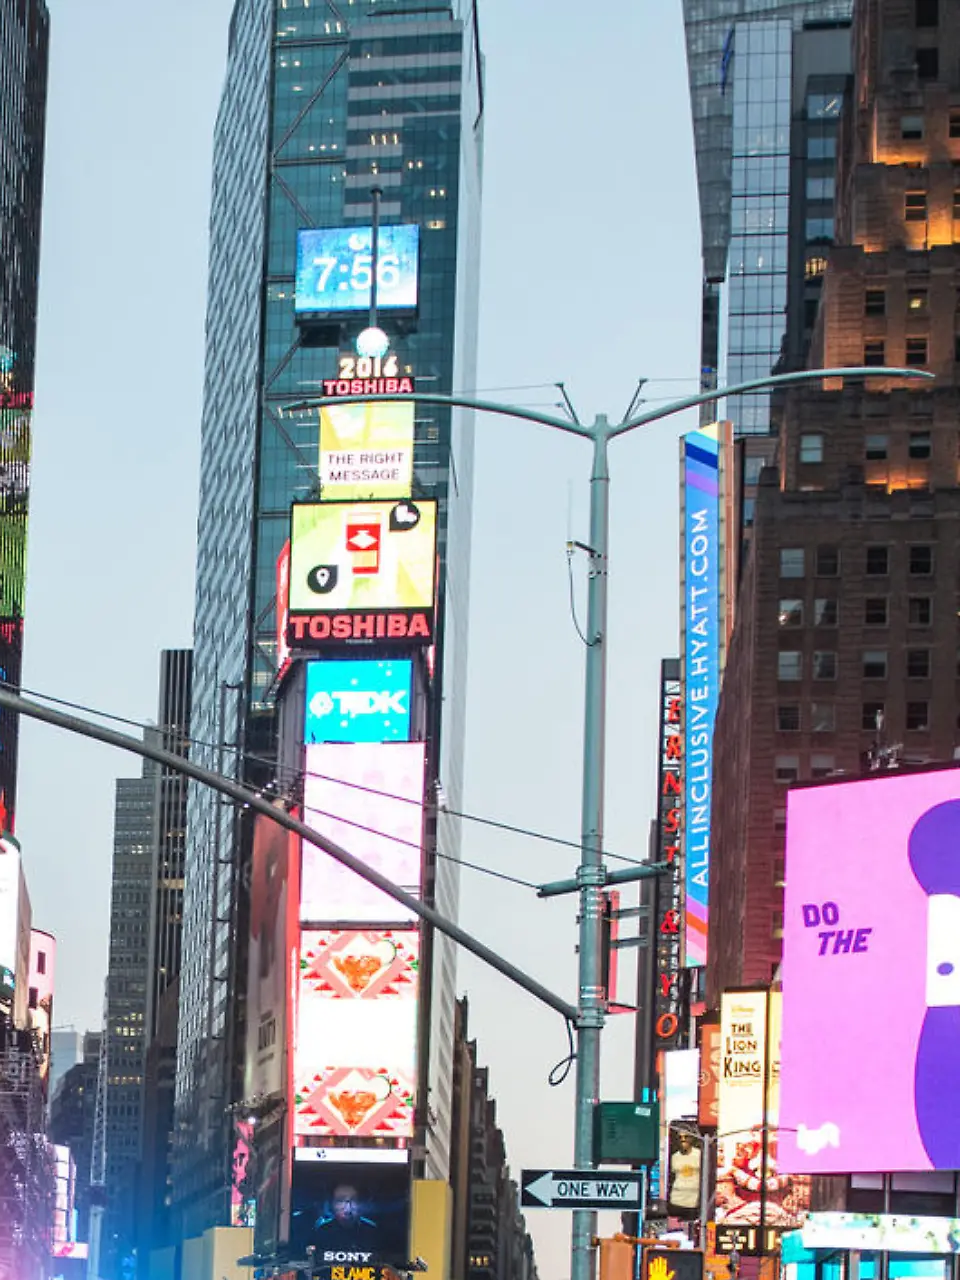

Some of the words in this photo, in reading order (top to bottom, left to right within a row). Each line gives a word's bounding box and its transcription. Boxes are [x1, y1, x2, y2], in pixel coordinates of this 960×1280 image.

[313, 252, 400, 292] 7:56
[338, 355, 399, 379] 2016
[323, 378, 413, 396] TOSHIBA
[328, 453, 354, 466] THE
[359, 452, 404, 465] RIGHT
[328, 469, 400, 481] MESSAGE
[289, 613, 430, 639] TOSHIBA
[331, 690, 407, 716] TDK
[662, 697, 682, 863] ERNST
[802, 901, 840, 928] DO
[818, 928, 873, 956] THE
[731, 1023, 752, 1034] THE
[726, 1036, 758, 1054] LION
[723, 1056, 761, 1079] KING
[557, 1182, 589, 1197] ONE
[596, 1183, 629, 1197] WAY
[323, 1251, 373, 1262] SONY
